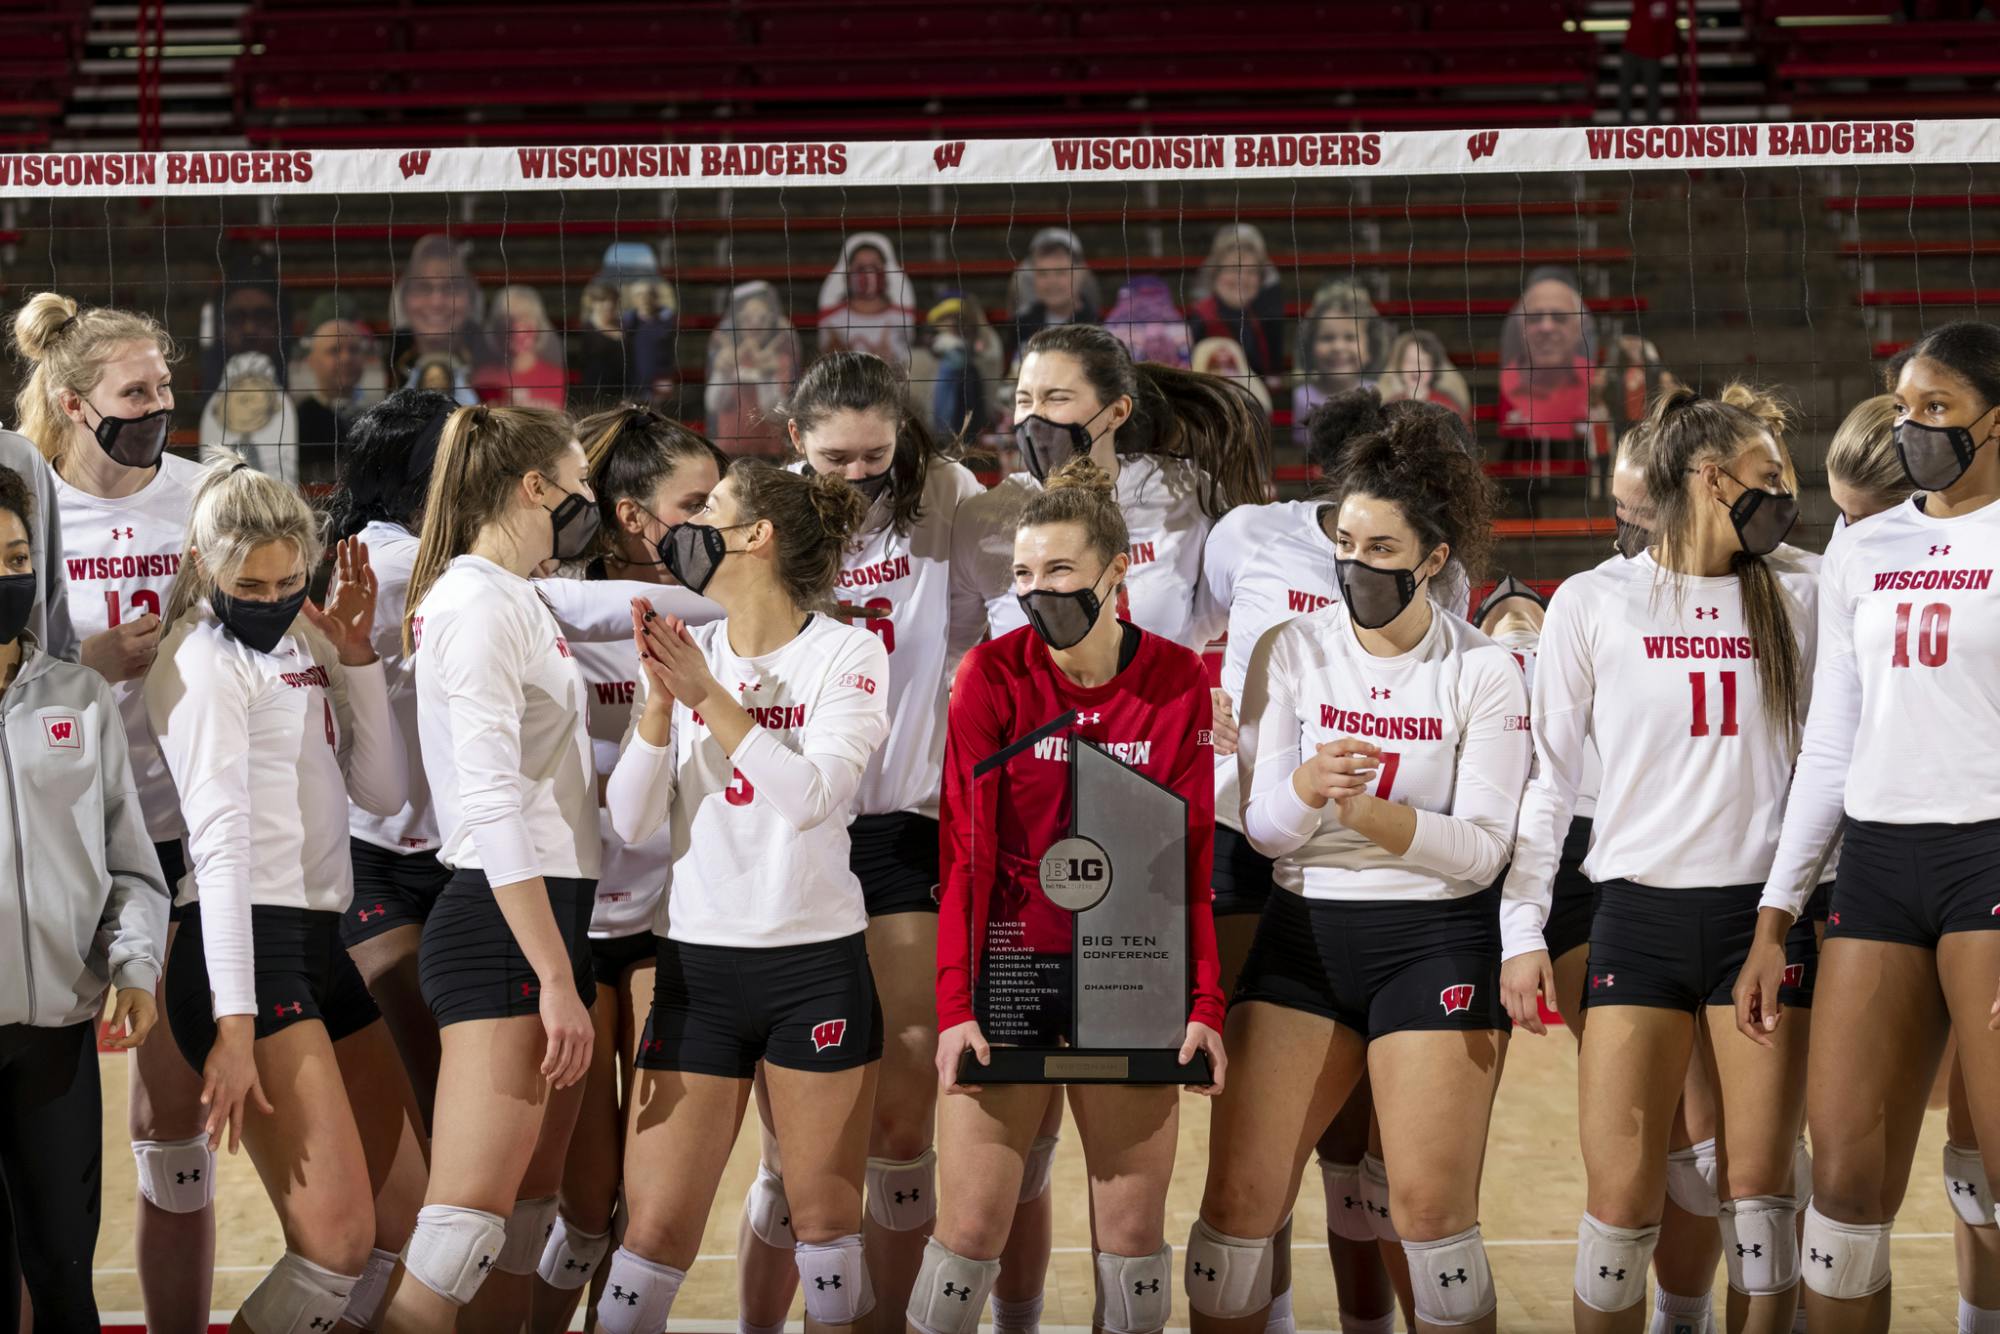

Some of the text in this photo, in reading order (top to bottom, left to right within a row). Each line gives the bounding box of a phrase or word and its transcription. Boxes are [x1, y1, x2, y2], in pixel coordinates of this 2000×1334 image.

[933, 142, 966, 171] W
[1053, 134, 1381, 171] WISCONSIN BADGERS
[1467, 131, 1499, 161] W
[1586, 122, 1915, 160] WISCONSIN BADGERS
[167, 151, 313, 184] BADGERS
[399, 150, 431, 177] W
[518, 143, 847, 178] WISCONSIN BADGERS
[1872, 569, 1993, 592] WISCONSIN
[1642, 635, 1761, 660] WISCONSI
[1891, 602, 1953, 669] 10
[1688, 671, 1739, 737] 11
[1319, 703, 1443, 741] WISCONSIN
[1374, 751, 1401, 801] 7
[1082, 936, 1157, 947] BIG TEN
[1083, 950, 1169, 960] CONFERENCE
[1440, 983, 1475, 1015] W
[811, 1018, 847, 1053] W
